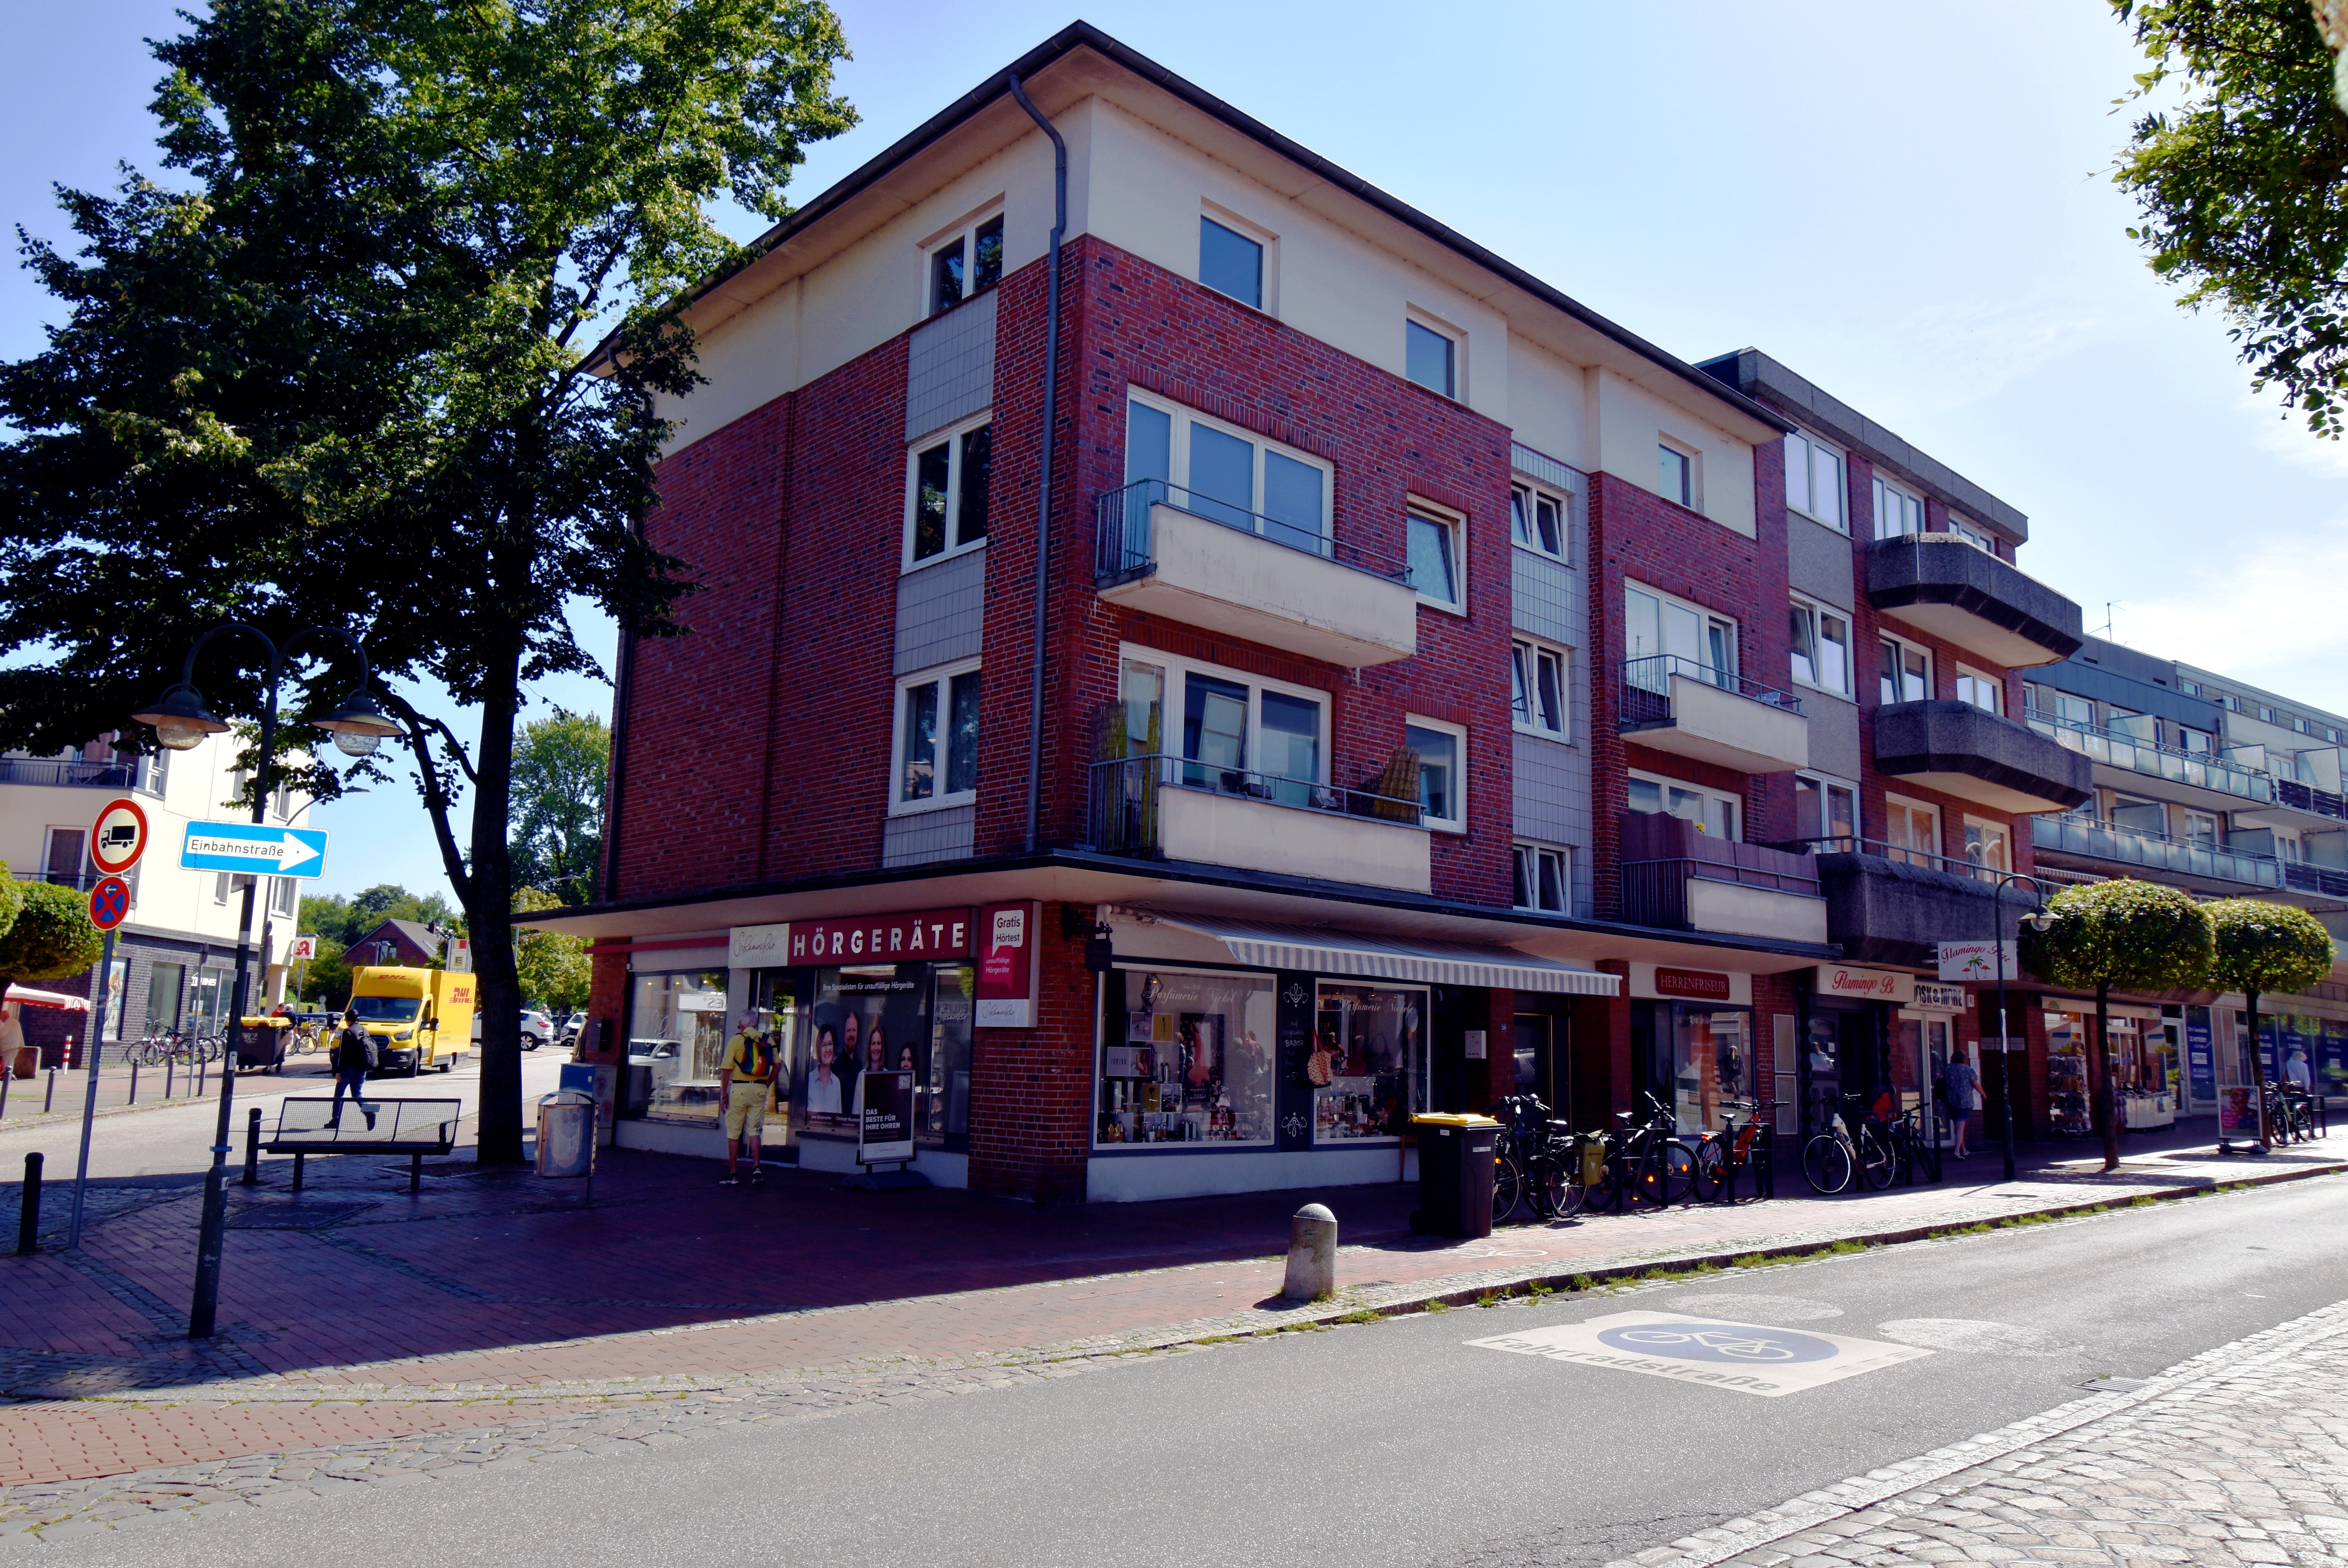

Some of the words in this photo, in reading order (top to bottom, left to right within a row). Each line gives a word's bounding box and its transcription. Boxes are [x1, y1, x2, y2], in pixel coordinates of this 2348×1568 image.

[191, 839, 284, 856] Einbahnstraße
[997, 916, 1020, 928] Gratis
[793, 919, 965, 957] HÖRGERÄTE
[996, 934, 1020, 942] Hörtest
[1941, 944, 1986, 963] Flamingo
[986, 966, 1010, 975] Hörgeräte
[864, 982, 891, 991] unauffällige
[891, 981, 914, 990] Hörgeräte
[1661, 975, 1726, 993] HERRENFRISEUR
[1832, 970, 1877, 994] Flamingo
[1144, 985, 1199, 1005] Parfümerie
[1914, 984, 1932, 1004] IOSK
[1941, 988, 1962, 1007] MORE
[884, 1113, 896, 1122] FÜR
[1482, 1337, 1780, 1391] Fahrradstraße
